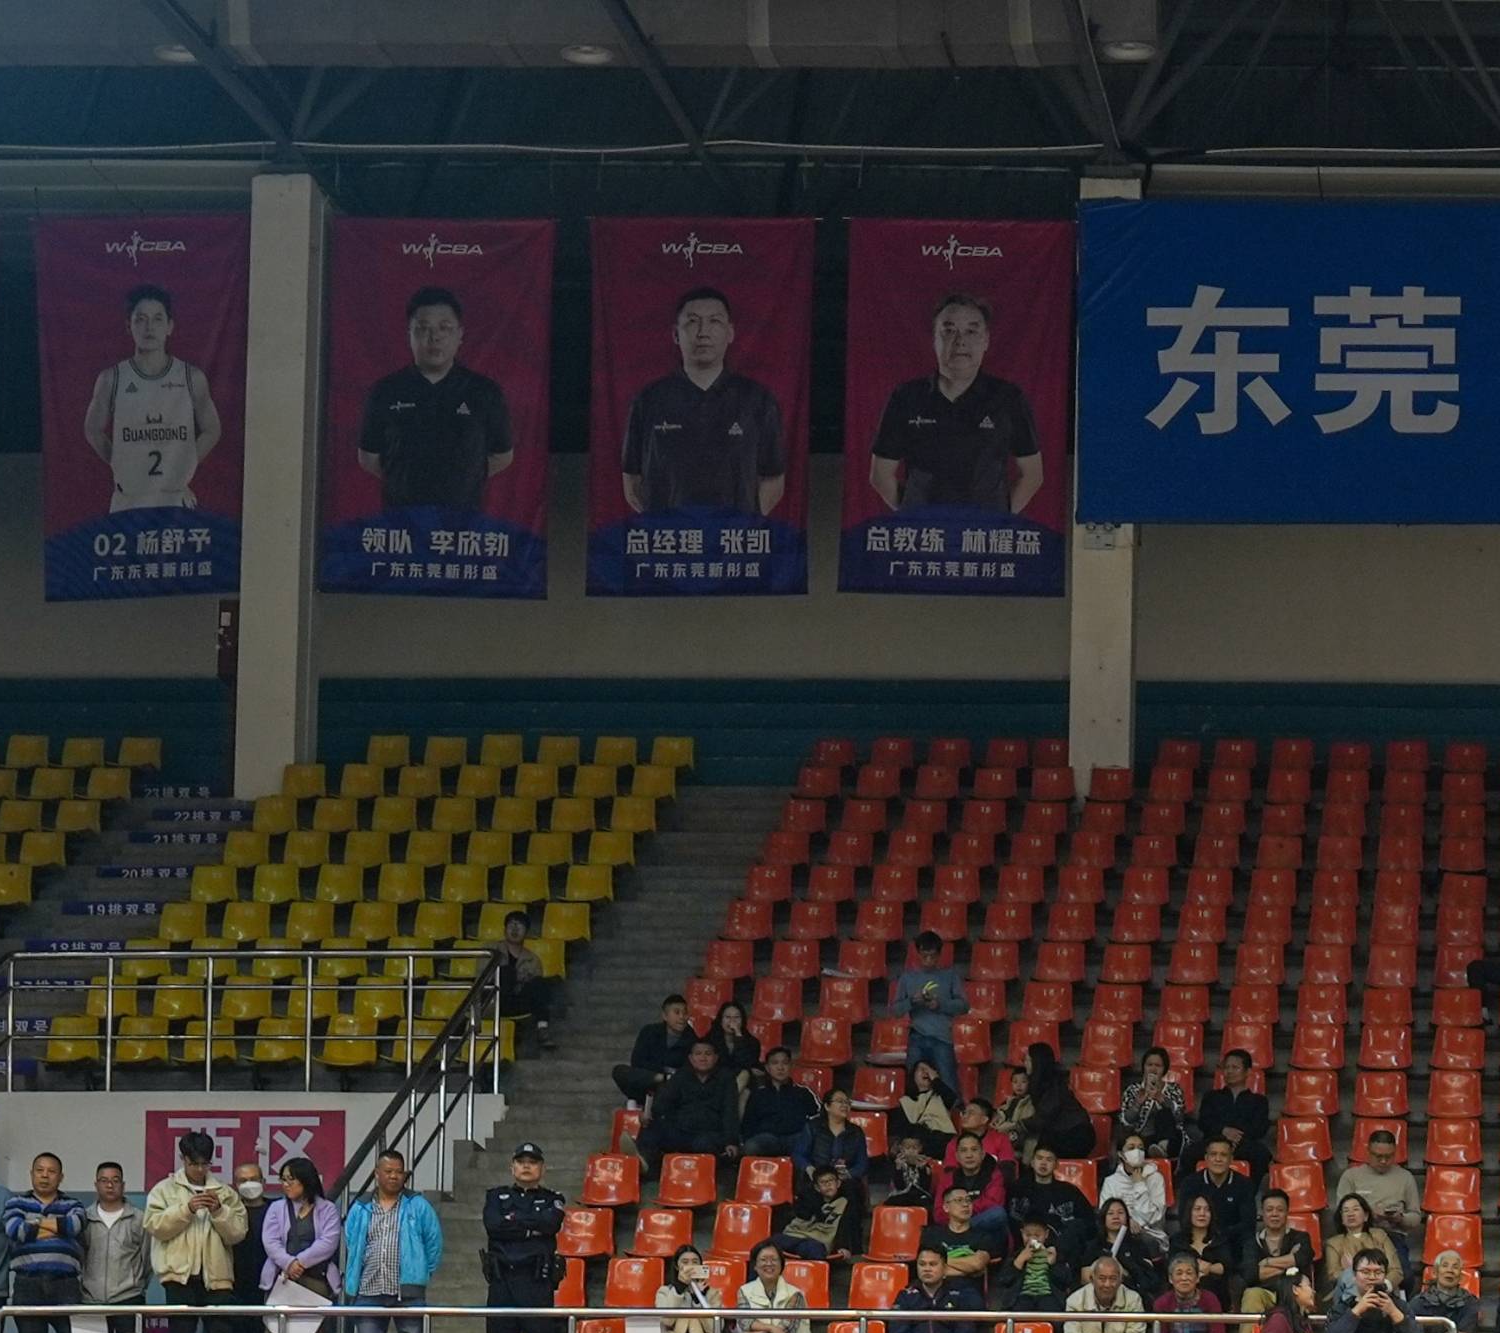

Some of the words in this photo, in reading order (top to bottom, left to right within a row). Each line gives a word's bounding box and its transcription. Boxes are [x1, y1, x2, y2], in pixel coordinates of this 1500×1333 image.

[122, 424, 188, 444] GUANGDONG
[147, 451, 163, 476] 2
[94, 532, 126, 558] 02
[137, 527, 211, 555] 杨舒予
[362, 527, 412, 554] 领队
[625, 529, 702, 555] 总经理
[720, 529, 771, 555] 张凯
[867, 525, 945, 553] 总教练
